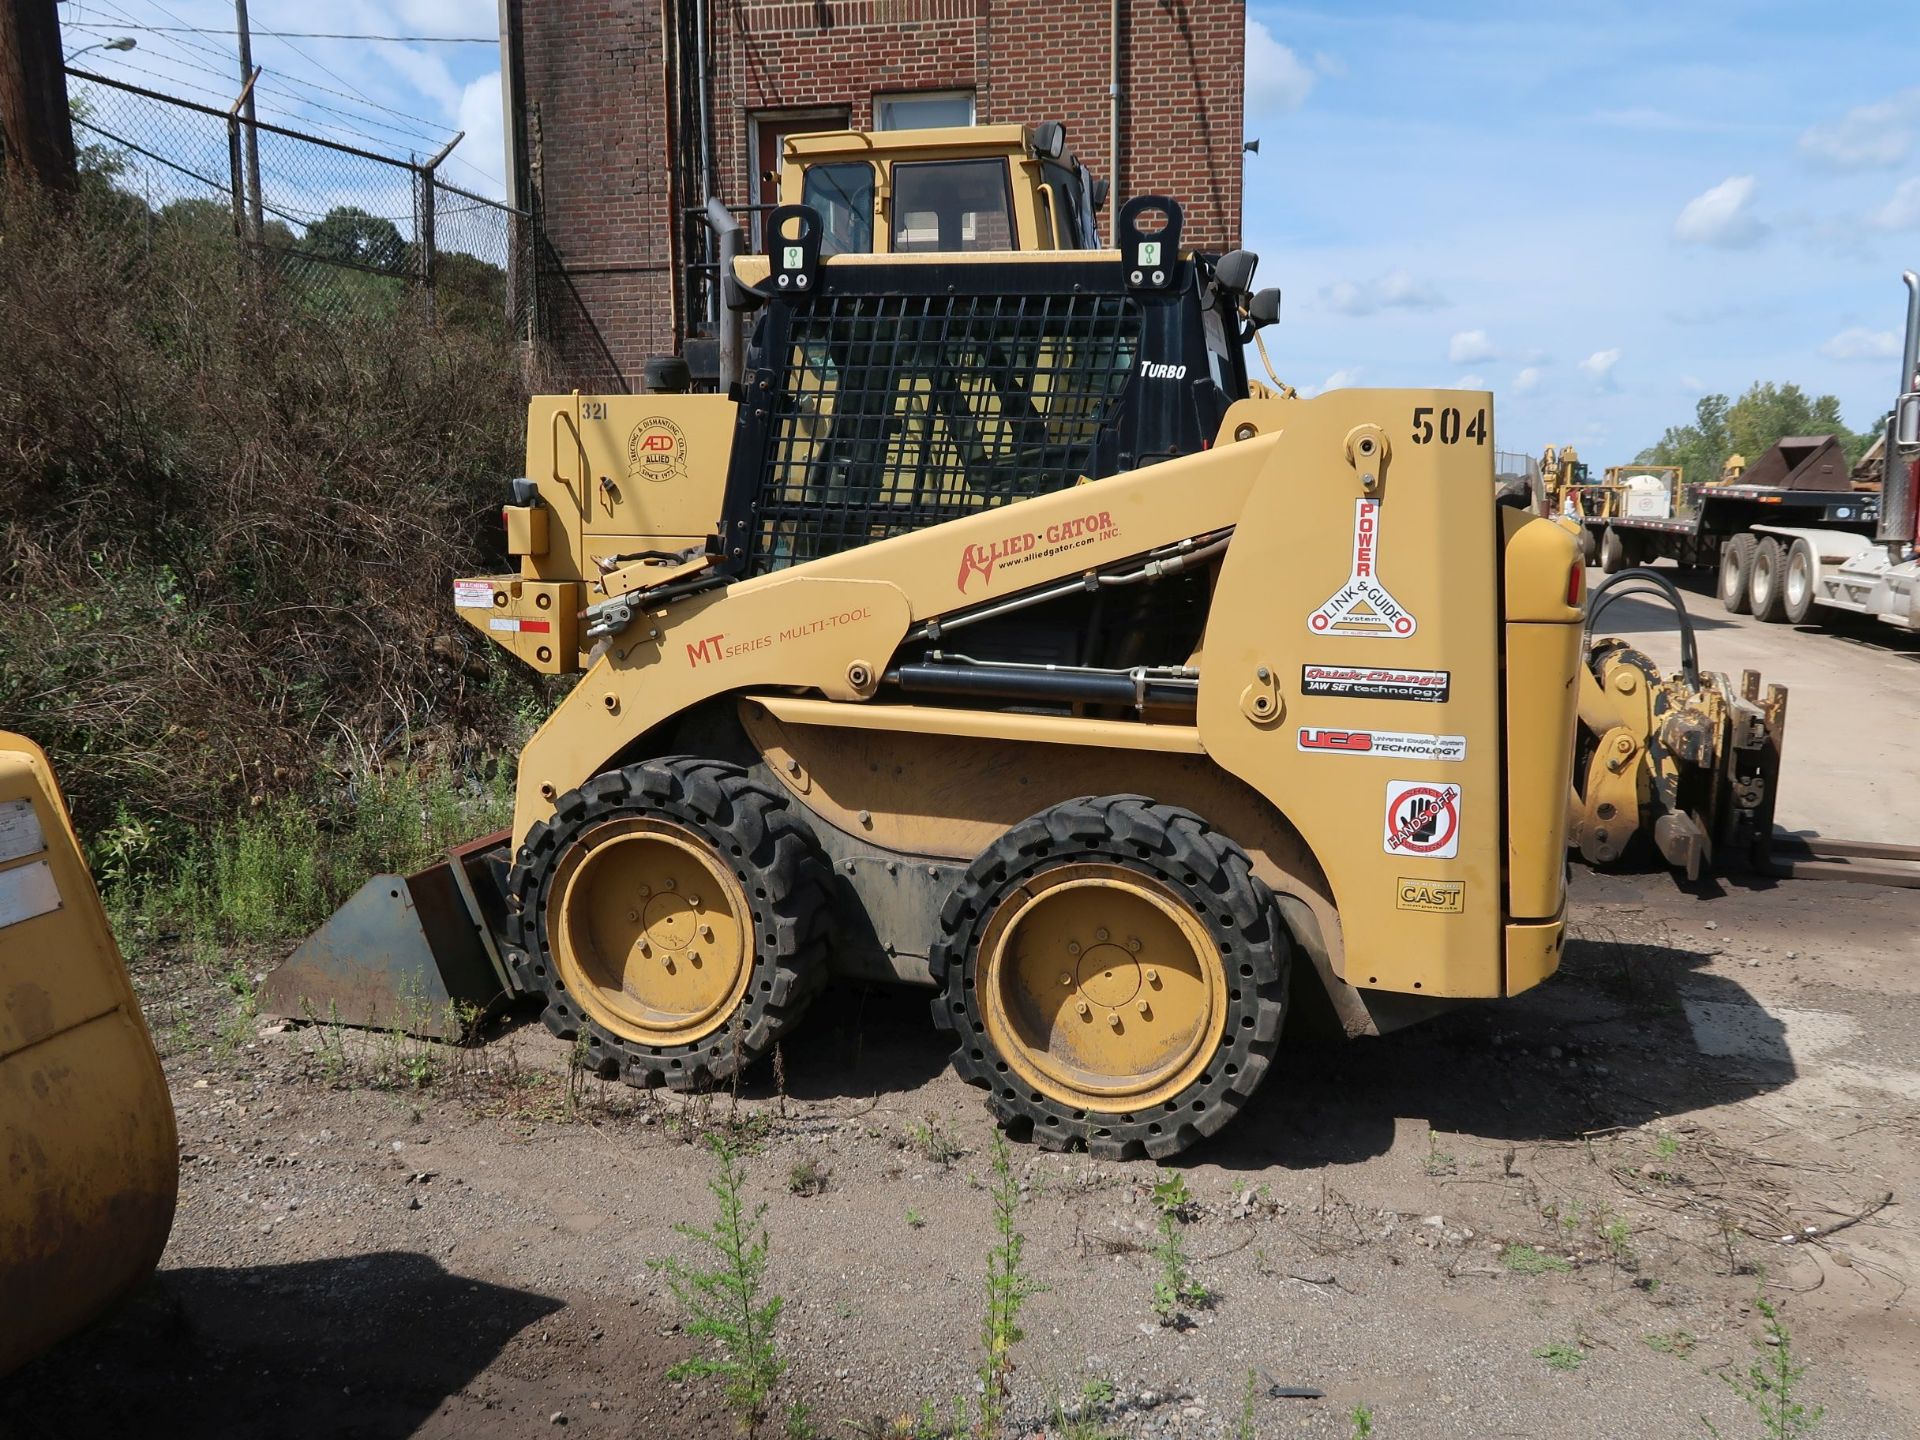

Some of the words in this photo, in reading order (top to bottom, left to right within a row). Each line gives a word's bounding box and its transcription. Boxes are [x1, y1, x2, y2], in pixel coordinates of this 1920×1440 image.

[1141, 361, 1187, 379] TURBO
[582, 402, 607, 420] 321
[642, 419, 680, 436] DISMANTLING
[1411, 407, 1487, 446] 504
[640, 435, 674, 451] AED
[646, 455, 670, 464] ALLIED
[641, 469, 658, 480] SINCE
[1099, 528, 1122, 542] INC.
[1356, 503, 1375, 577] POWER
[999, 537, 1095, 569] www.alliedgator.com
[1323, 586, 1359, 619] LINK
[1357, 581, 1368, 591] &
[1367, 588, 1402, 623] GUIDE
[686, 634, 725, 668] MT
[726, 636, 772, 658] SERIES
[779, 607, 872, 643] MULTI-TOOL
[1306, 668, 1447, 686] Quick-Change
[1307, 682, 1330, 691] JAW
[1331, 683, 1353, 692] SET
[1353, 685, 1443, 697] technology
[1300, 730, 1373, 751] UCS
[1374, 743, 1461, 756] TECHNOLOGY
[1429, 786, 1458, 815] OFF!
[1401, 886, 1461, 905] CAST
